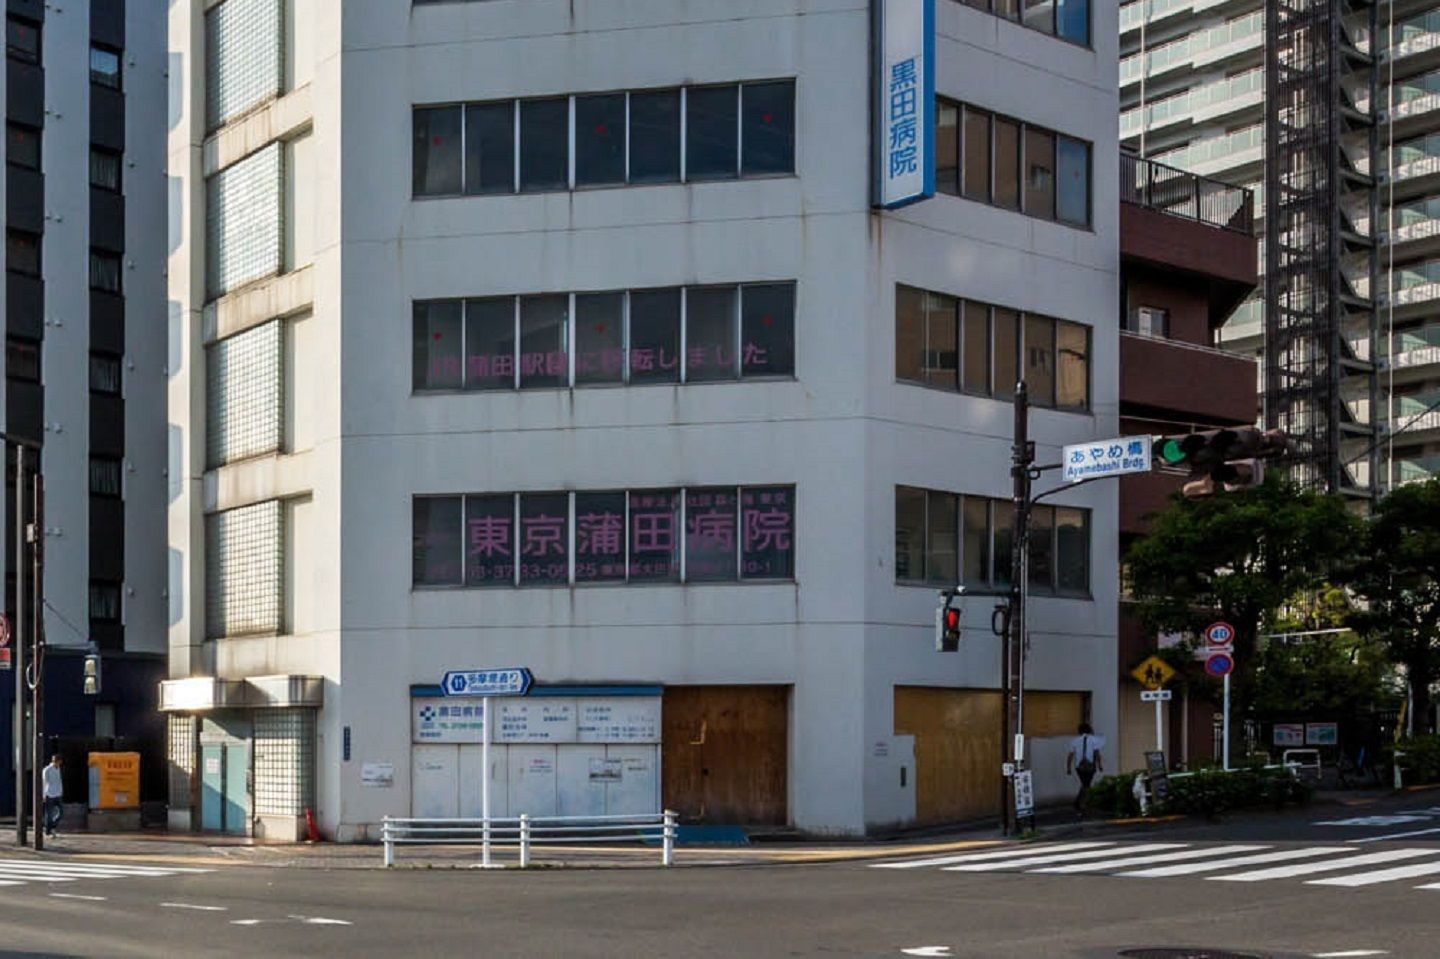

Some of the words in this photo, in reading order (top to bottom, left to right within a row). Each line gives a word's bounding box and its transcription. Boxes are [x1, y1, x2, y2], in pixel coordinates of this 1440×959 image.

[890, 58, 917, 179] 黒田病院
[1070, 441, 1143, 463] あやめ橋
[1067, 459, 1120, 478] Ayamebashi
[468, 508, 791, 556] 東京蒲田病院
[1211, 628, 1228, 640] 40
